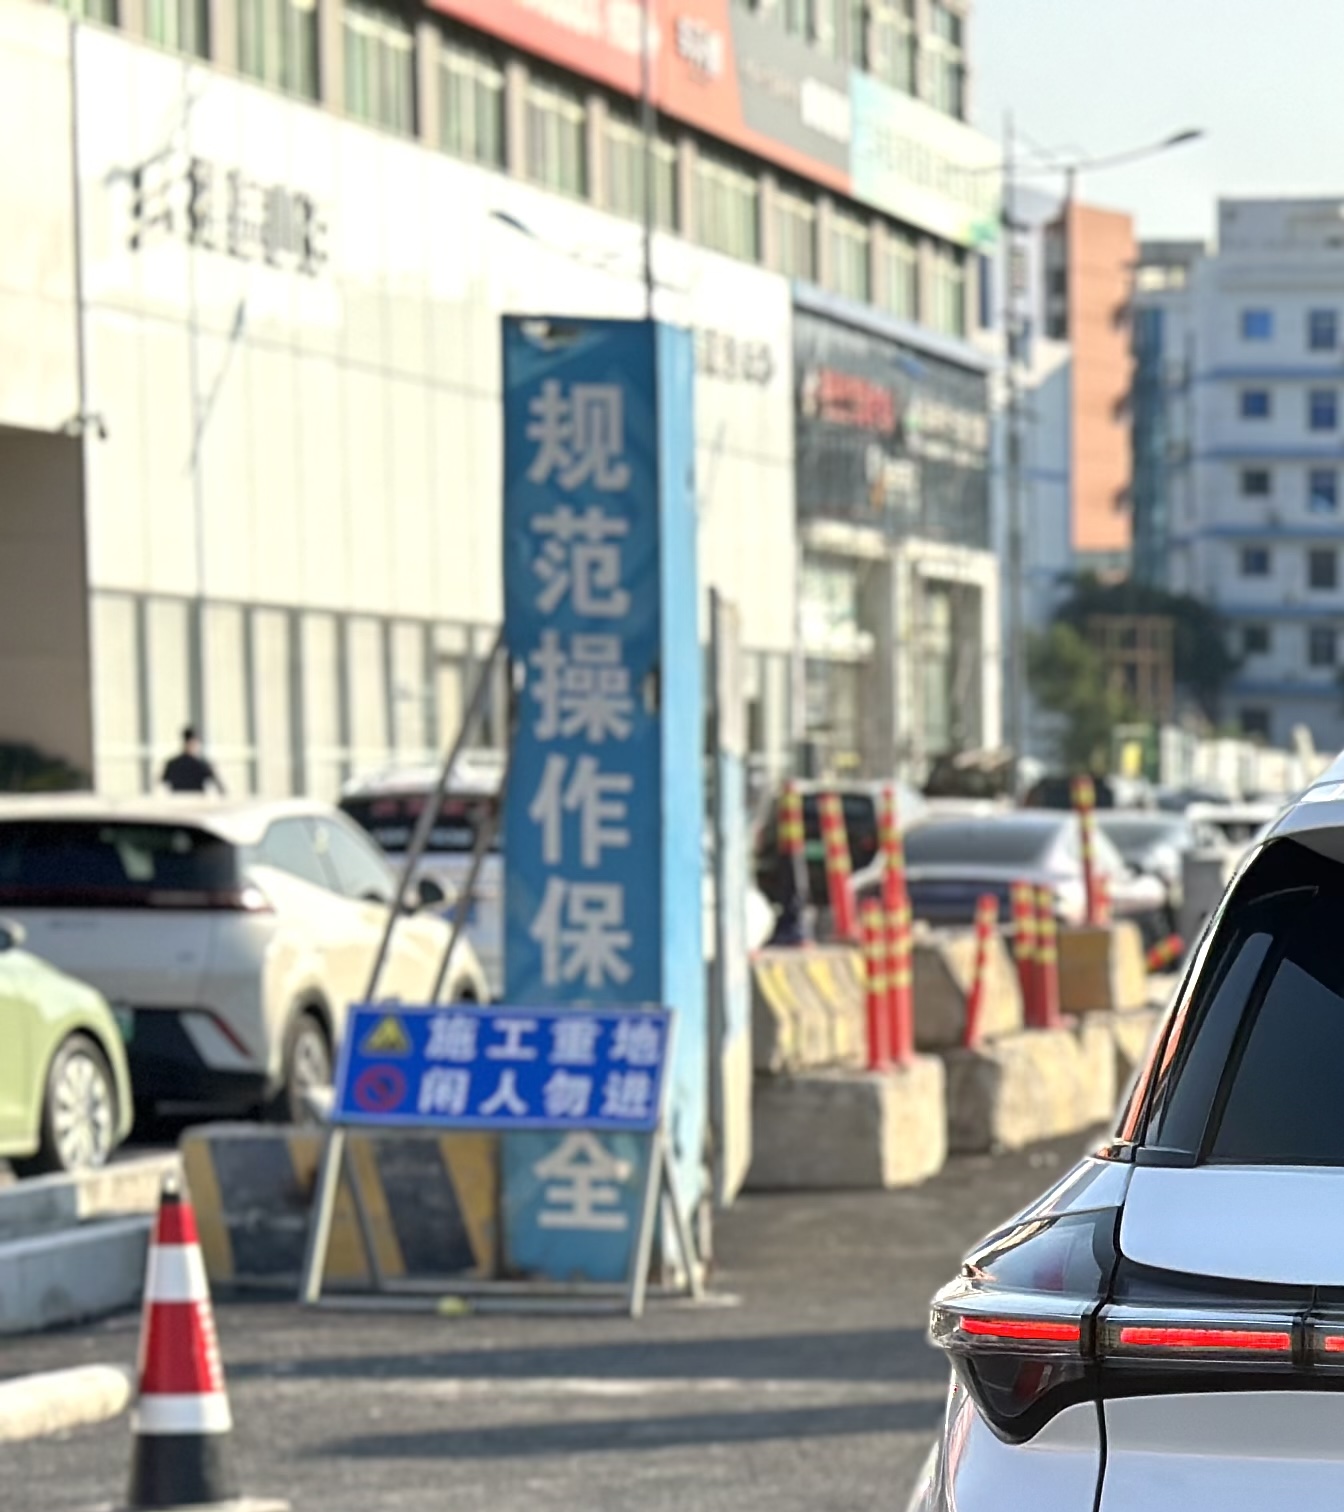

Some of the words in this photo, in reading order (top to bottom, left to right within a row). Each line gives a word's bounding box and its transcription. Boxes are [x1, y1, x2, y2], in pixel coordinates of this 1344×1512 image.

[527, 377, 635, 1231] 规范操作保全
[424, 1014, 660, 1066] 施工重地
